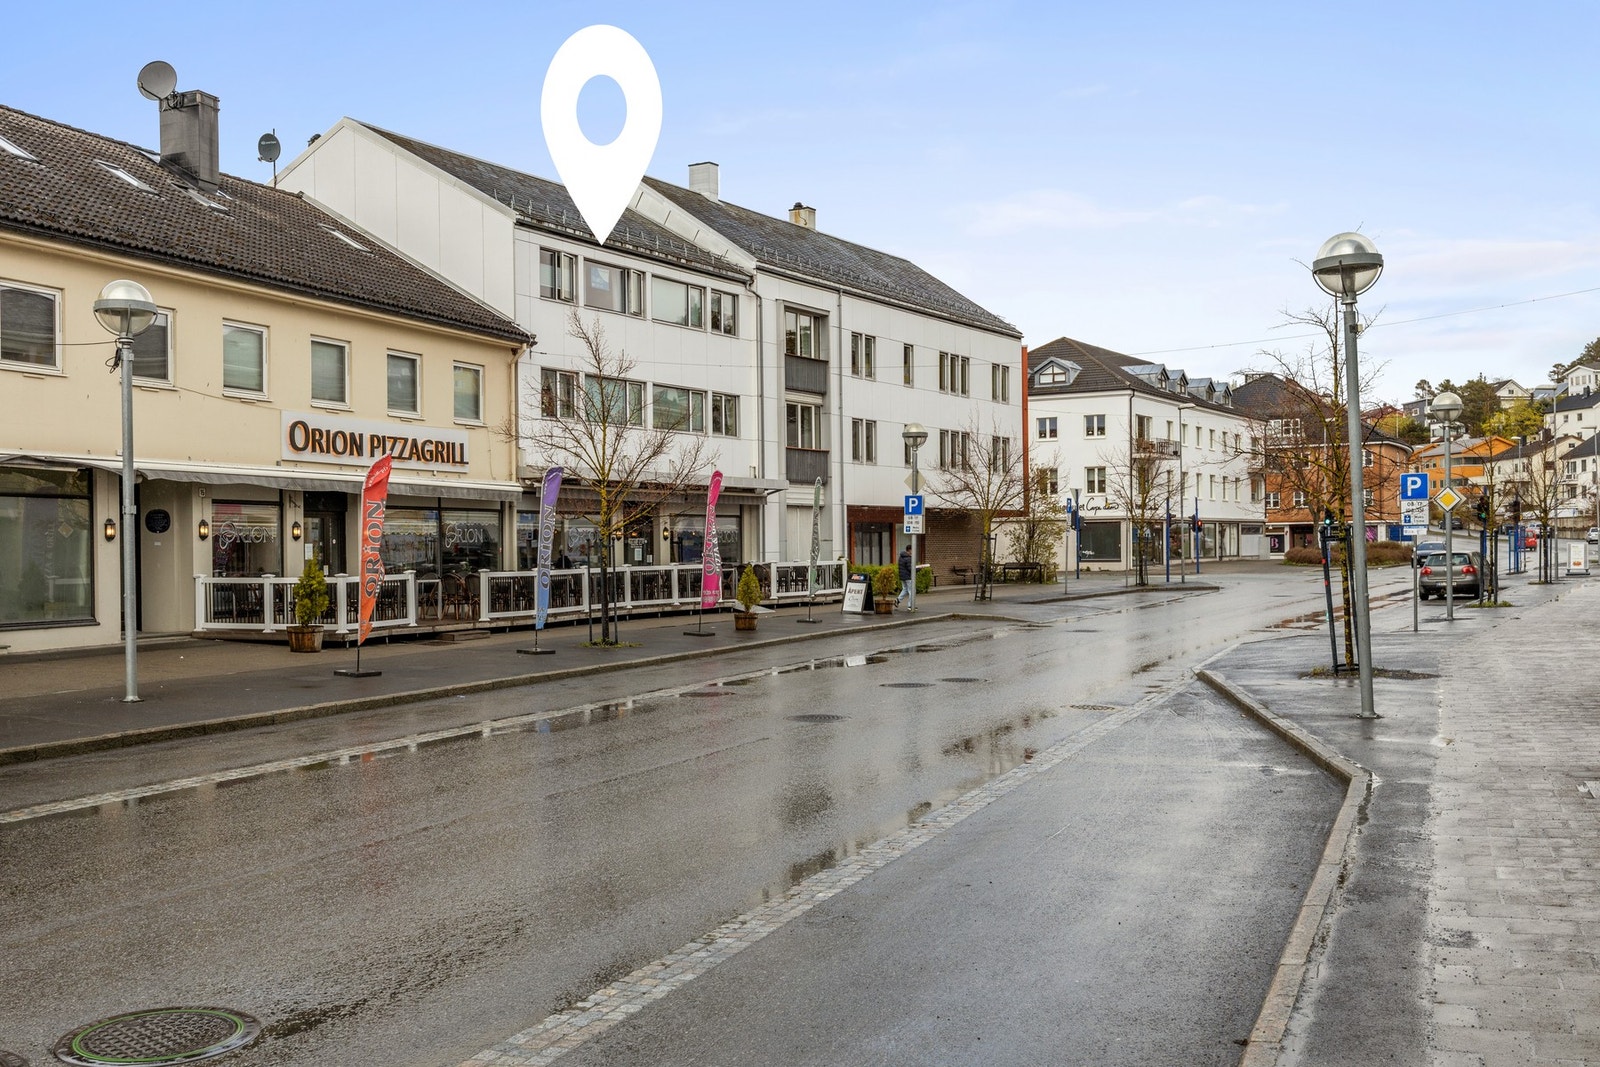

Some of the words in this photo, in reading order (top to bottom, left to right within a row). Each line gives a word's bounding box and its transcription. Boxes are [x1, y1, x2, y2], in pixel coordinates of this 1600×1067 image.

[289, 420, 364, 457] ORION
[369, 434, 469, 465] PIZZAGRILL
[1406, 476, 1422, 497] P
[908, 497, 919, 513] P
